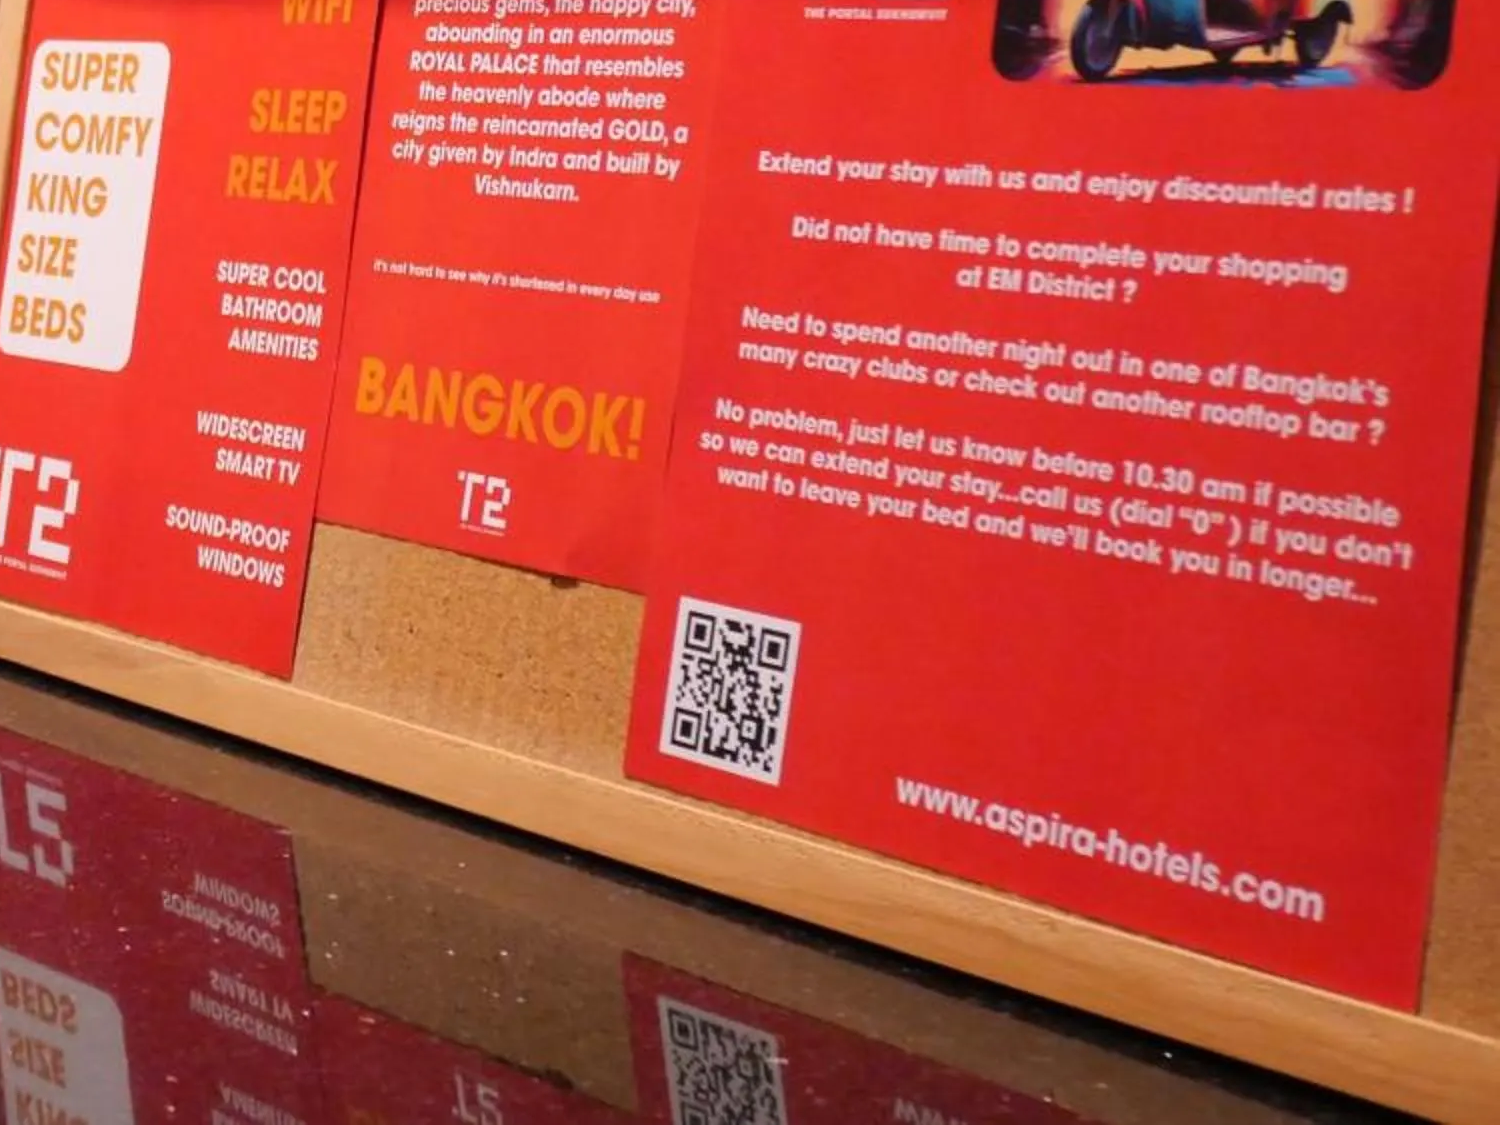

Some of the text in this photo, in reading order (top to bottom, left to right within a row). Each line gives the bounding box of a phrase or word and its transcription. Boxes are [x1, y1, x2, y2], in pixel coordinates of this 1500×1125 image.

[425, 22, 675, 49] abounding in an enormous
[42, 52, 140, 93] SUPER
[410, 50, 684, 78] ROYAL PALACE that resembles
[249, 89, 347, 136] SLEEP
[392, 109, 688, 147] reigns the reincarnated GOLD, a
[35, 113, 154, 158] COMFY
[27, 173, 108, 218] KING
[226, 154, 338, 205] RELAX
[475, 173, 579, 201] Vishnukarn.
[758, 151, 1396, 213] Extend your stay with us and enjoy discounted rates
[17, 234, 77, 278] SIZE
[792, 215, 1348, 293] Did not have time to complete your shopping
[216, 260, 326, 294] SUPER COOL
[408, 263, 434, 278] hard
[468, 271, 490, 286] why
[579, 283, 612, 300] every
[613, 286, 636, 303] day
[956, 266, 1116, 301] at EM District
[9, 294, 87, 344] BEDS
[221, 294, 322, 327] BATHROOM
[228, 328, 318, 361] AMENITIES
[741, 305, 1389, 407] Need to spend another night out in one of Bangkok's
[355, 355, 646, 461] BANGKOK!
[739, 342, 1361, 442] many crazy clubs or check out another rooftop bar
[197, 411, 305, 451] WIDESCREEN
[215, 448, 301, 486] SMART TV
[715, 397, 1400, 527] No problem, just let us know before 10.30 am if possible
[165, 504, 290, 553] SOUND-PROOF
[198, 545, 285, 588] WINDOWS
[896, 776, 1325, 922] www.aspira-hotels.com
